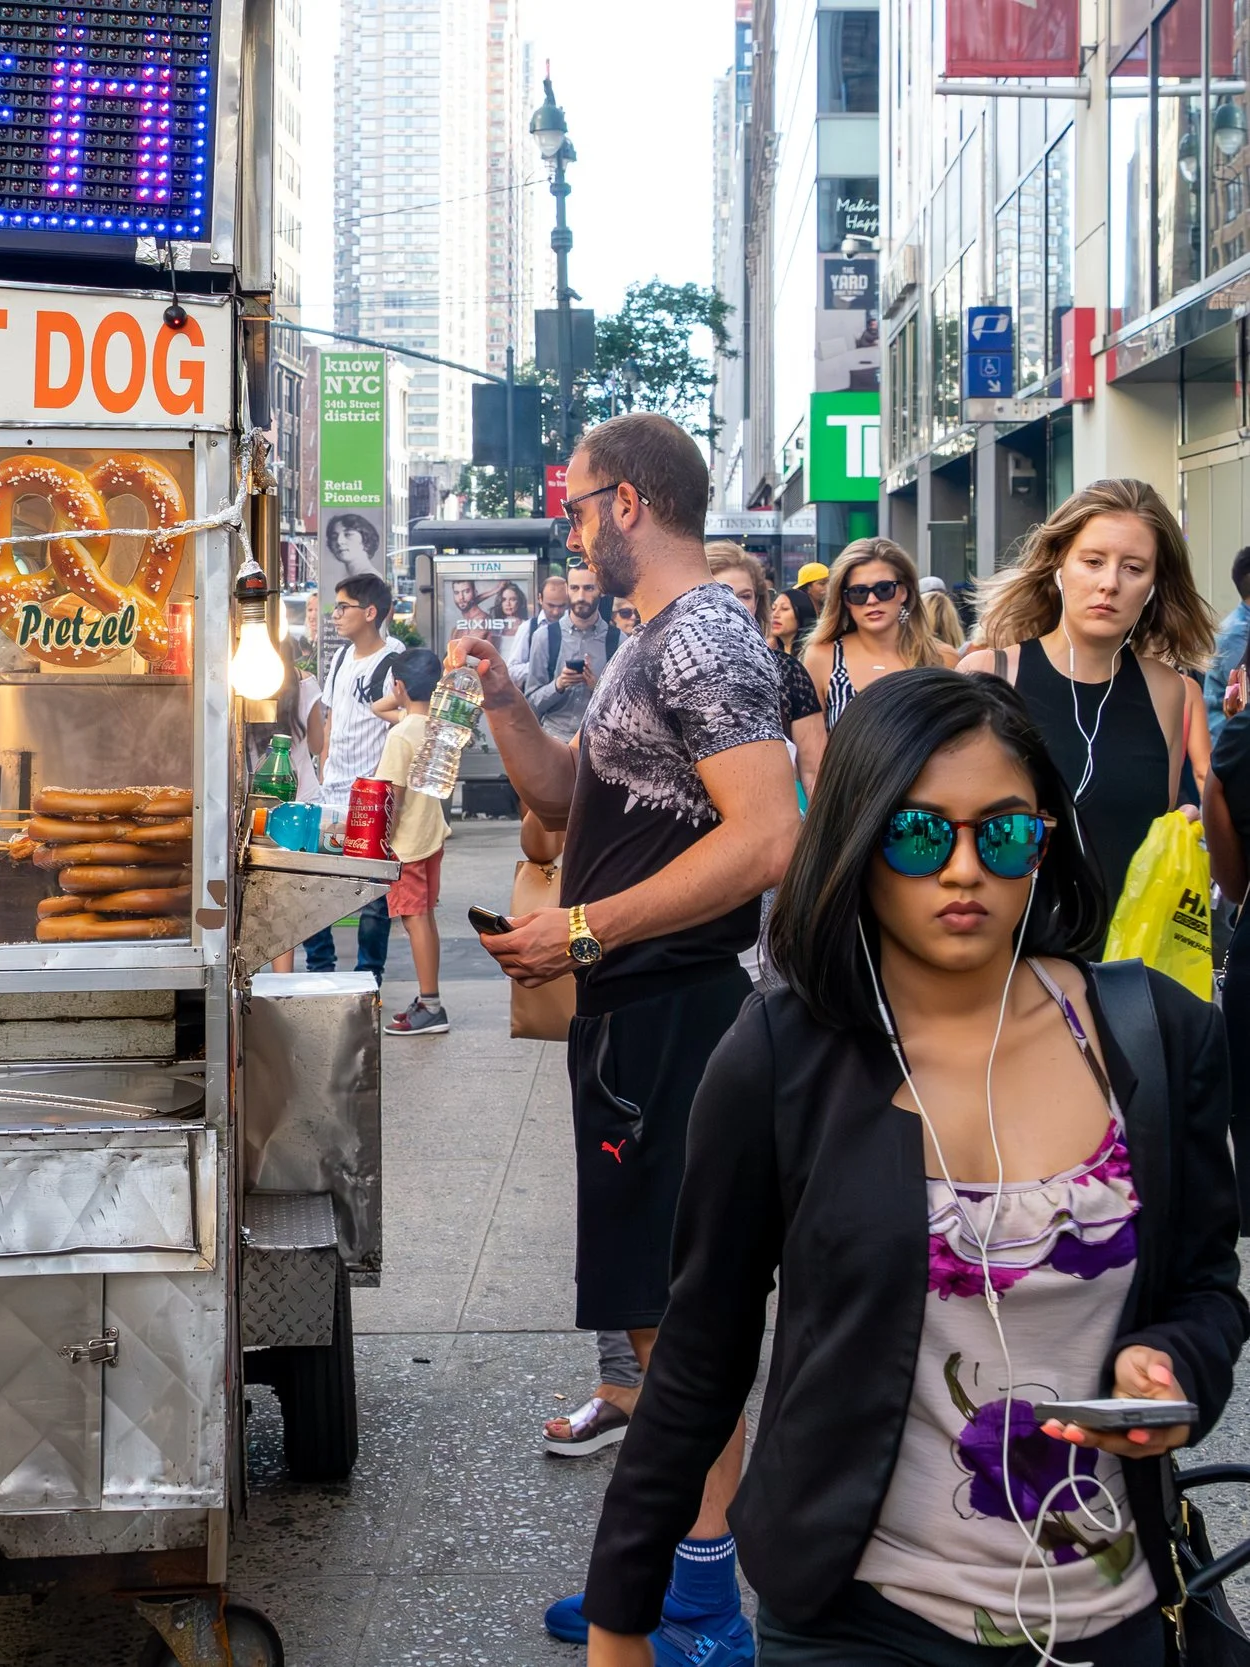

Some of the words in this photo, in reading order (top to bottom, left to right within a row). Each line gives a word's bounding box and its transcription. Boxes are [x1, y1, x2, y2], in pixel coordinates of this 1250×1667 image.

[830, 275, 869, 290] YARD
[34, 310, 206, 414] DOG
[324, 357, 381, 373] know
[324, 376, 381, 395] NYC
[324, 400, 347, 409] 34th
[349, 400, 380, 409] Street
[324, 410, 381, 422] district
[324, 480, 363, 491] Retail
[324, 492, 381, 503] Pioneers
[470, 563, 501, 571] TITAN
[18, 603, 136, 648] Pretzel
[455, 618, 515, 630] 2(X)IST
[352, 811, 369, 819] like
